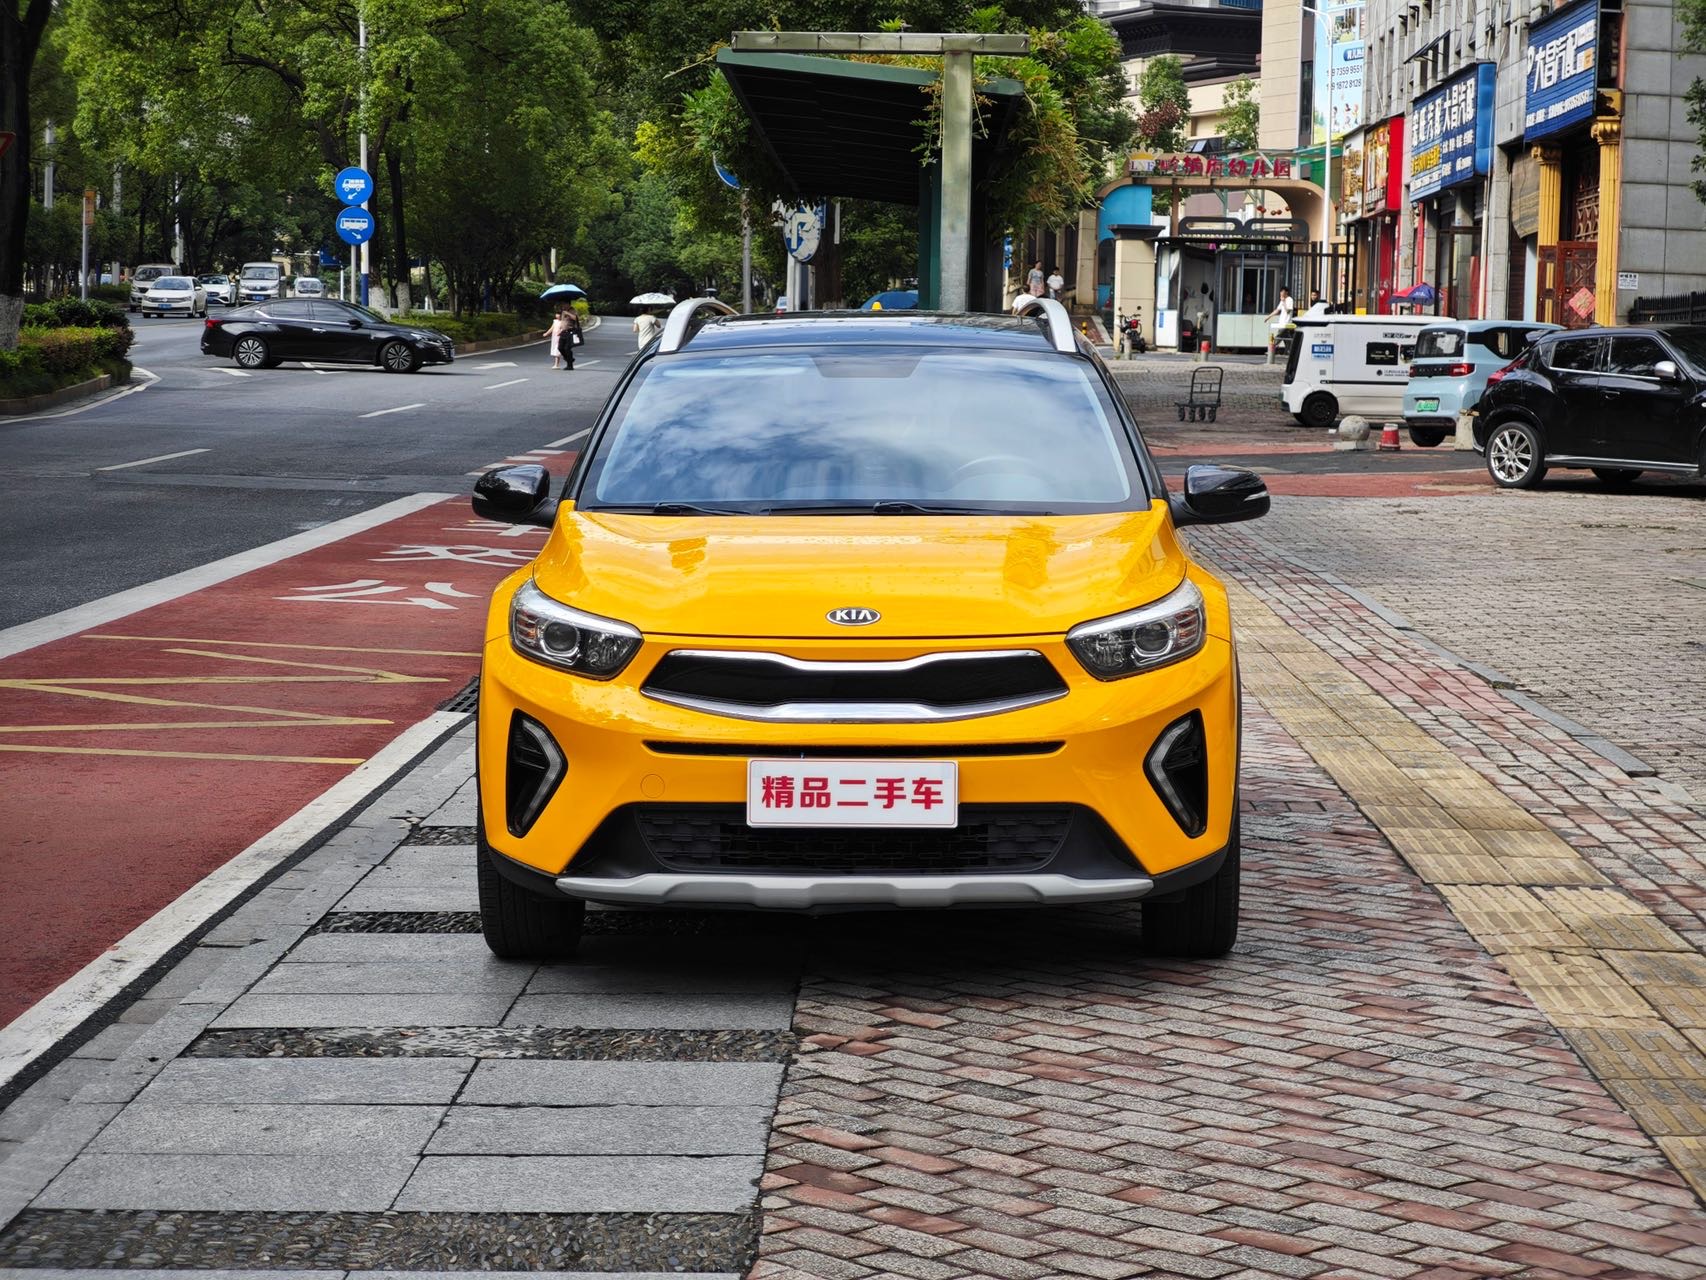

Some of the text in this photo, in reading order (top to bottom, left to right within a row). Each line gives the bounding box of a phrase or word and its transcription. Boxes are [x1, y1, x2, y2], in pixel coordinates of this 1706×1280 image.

[1533, 29, 1577, 92] 大昌汽配
[1443, 77, 1475, 132] 大昌汽配
[836, 609, 872, 621] KIA
[762, 776, 943, 809] 精品二手车
